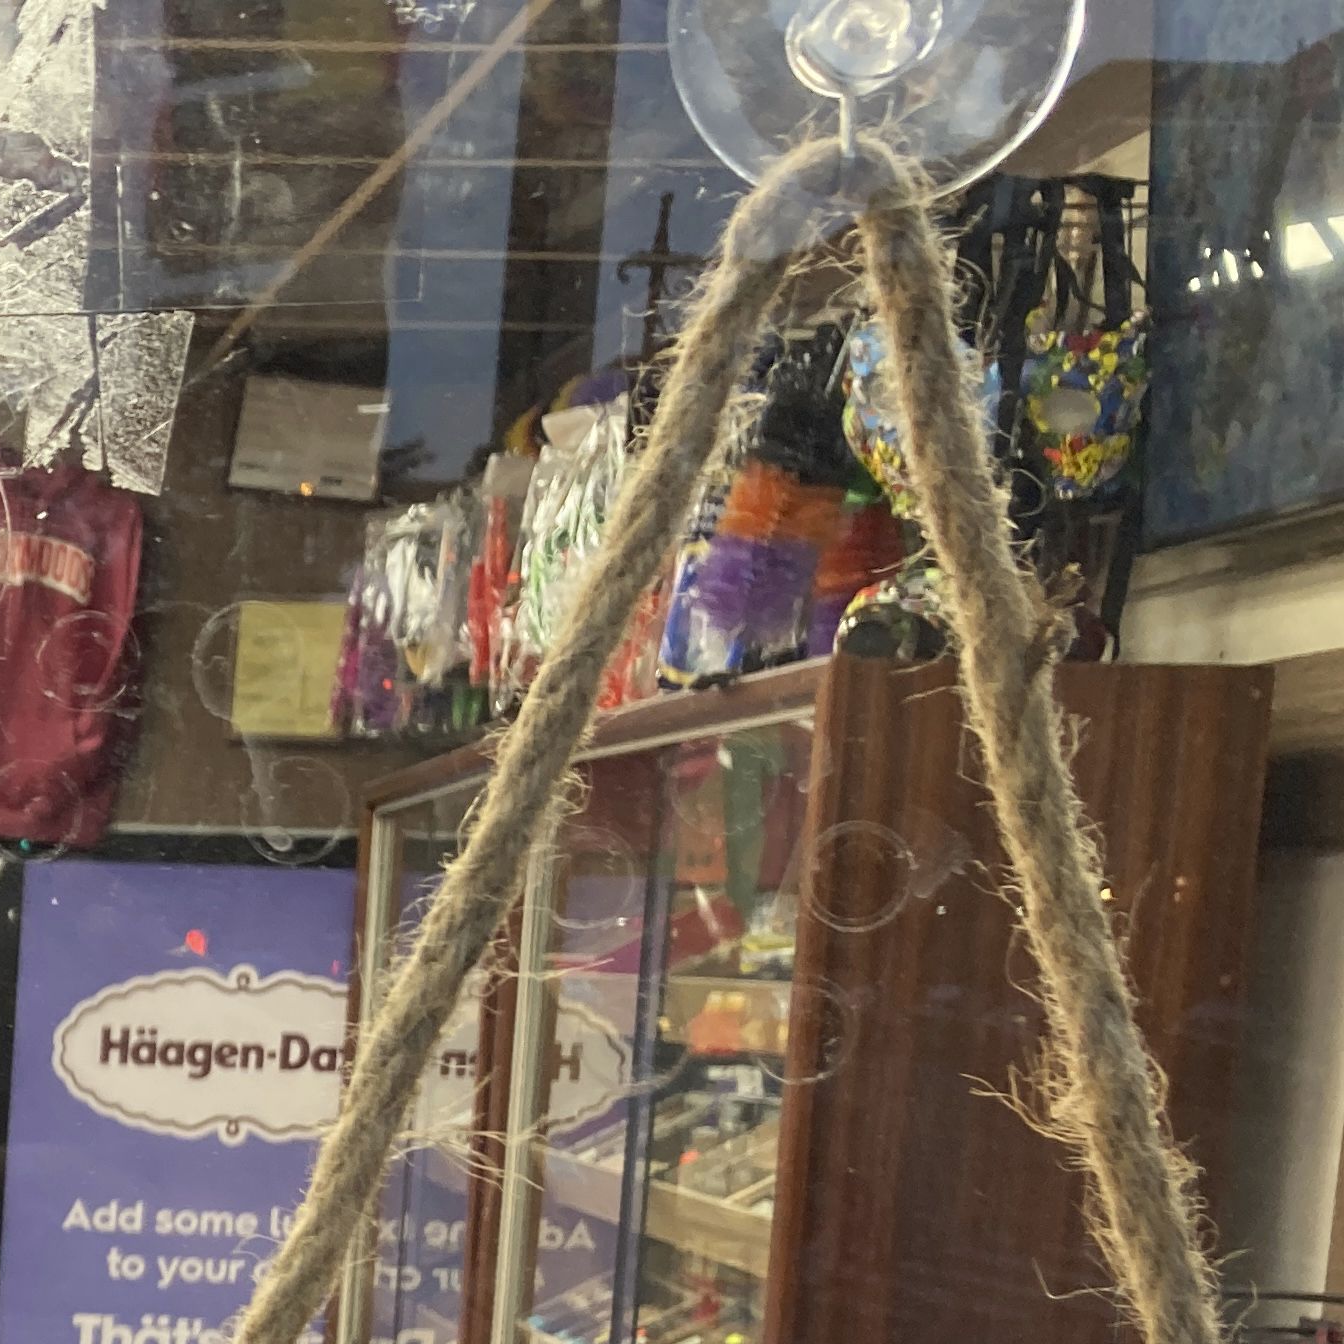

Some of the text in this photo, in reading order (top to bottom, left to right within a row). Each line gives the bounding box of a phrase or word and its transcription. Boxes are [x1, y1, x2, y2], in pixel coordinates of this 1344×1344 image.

[63, 1198, 144, 1234] Add
[155, 1208, 258, 1236] some
[107, 1246, 146, 1281] to
[156, 1255, 246, 1290] your
